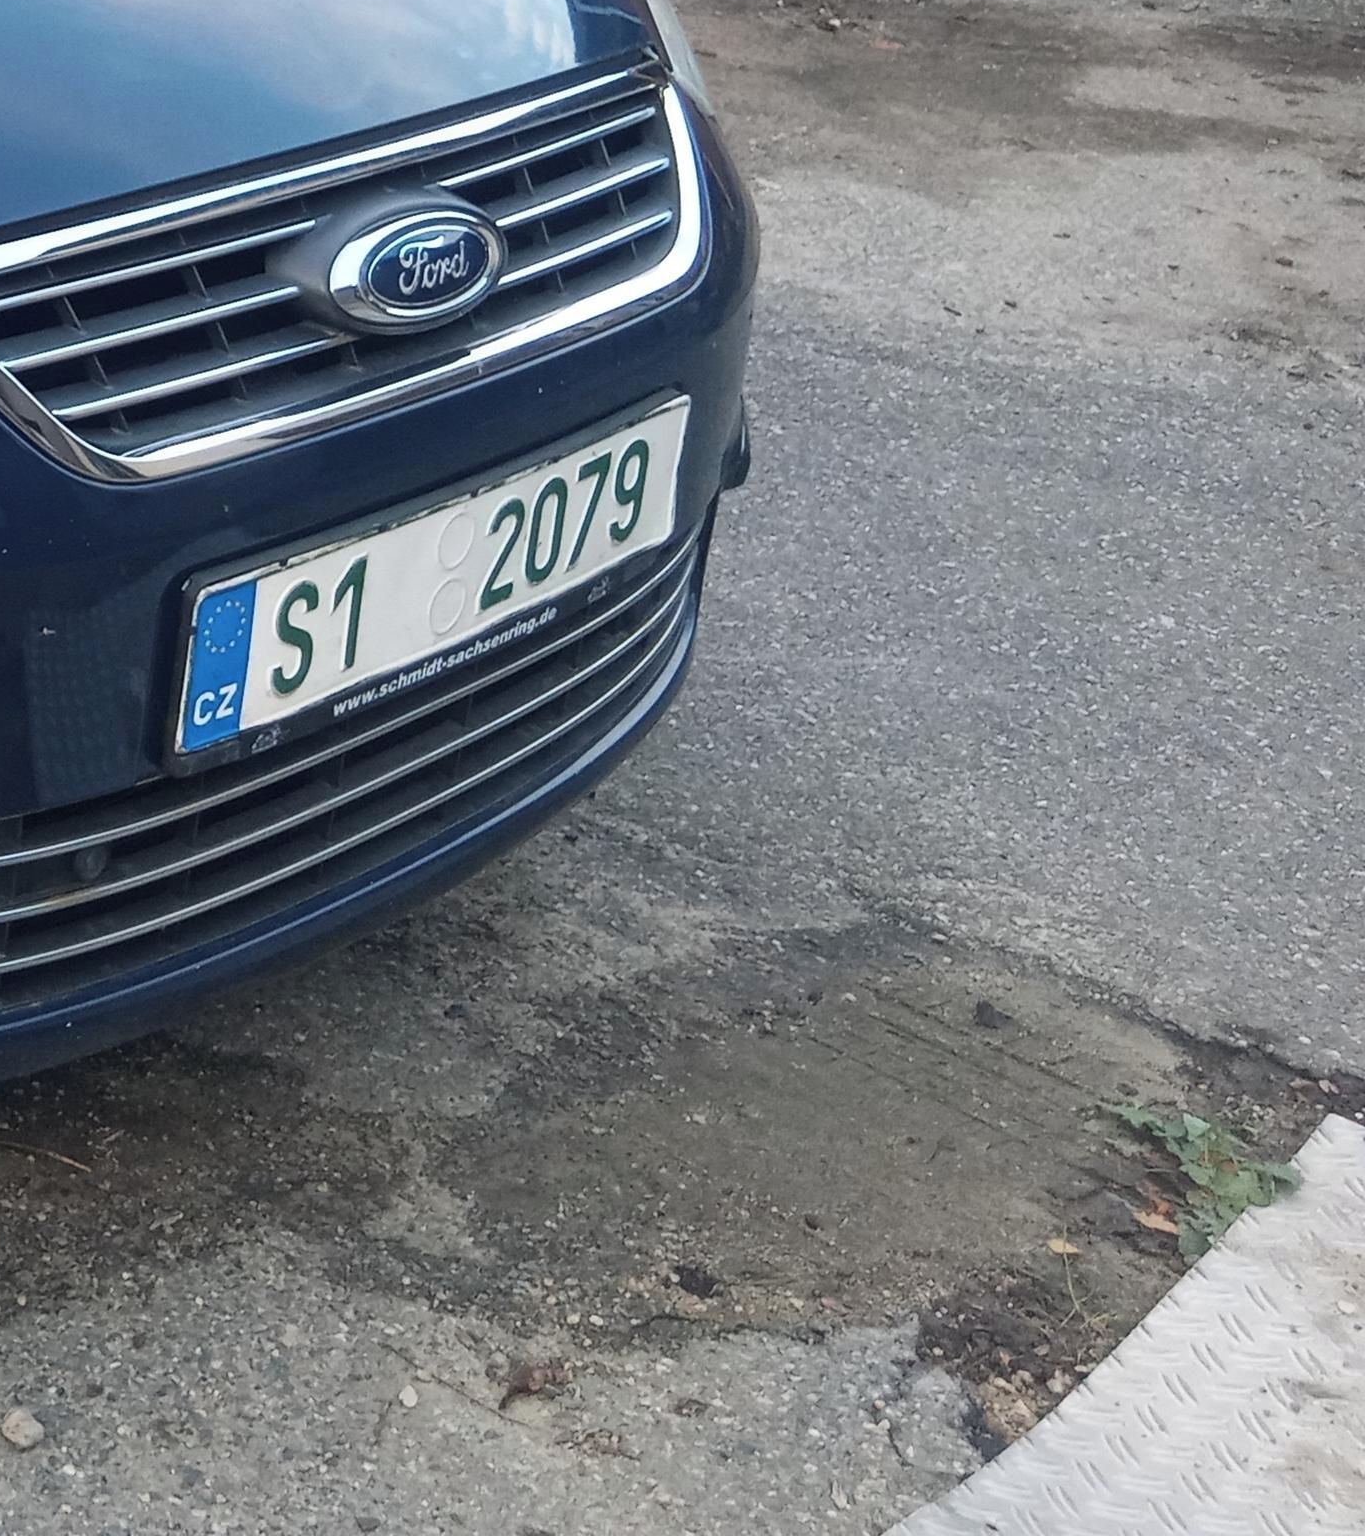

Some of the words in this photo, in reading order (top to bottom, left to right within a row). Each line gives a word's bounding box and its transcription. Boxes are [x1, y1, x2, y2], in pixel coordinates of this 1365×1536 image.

[398, 235, 470, 296] Ford
[271, 551, 369, 696] S1
[475, 438, 651, 614] 2079
[192, 683, 238, 727] CZ
[332, 605, 558, 718] www.schmidt-sachsenring.de
